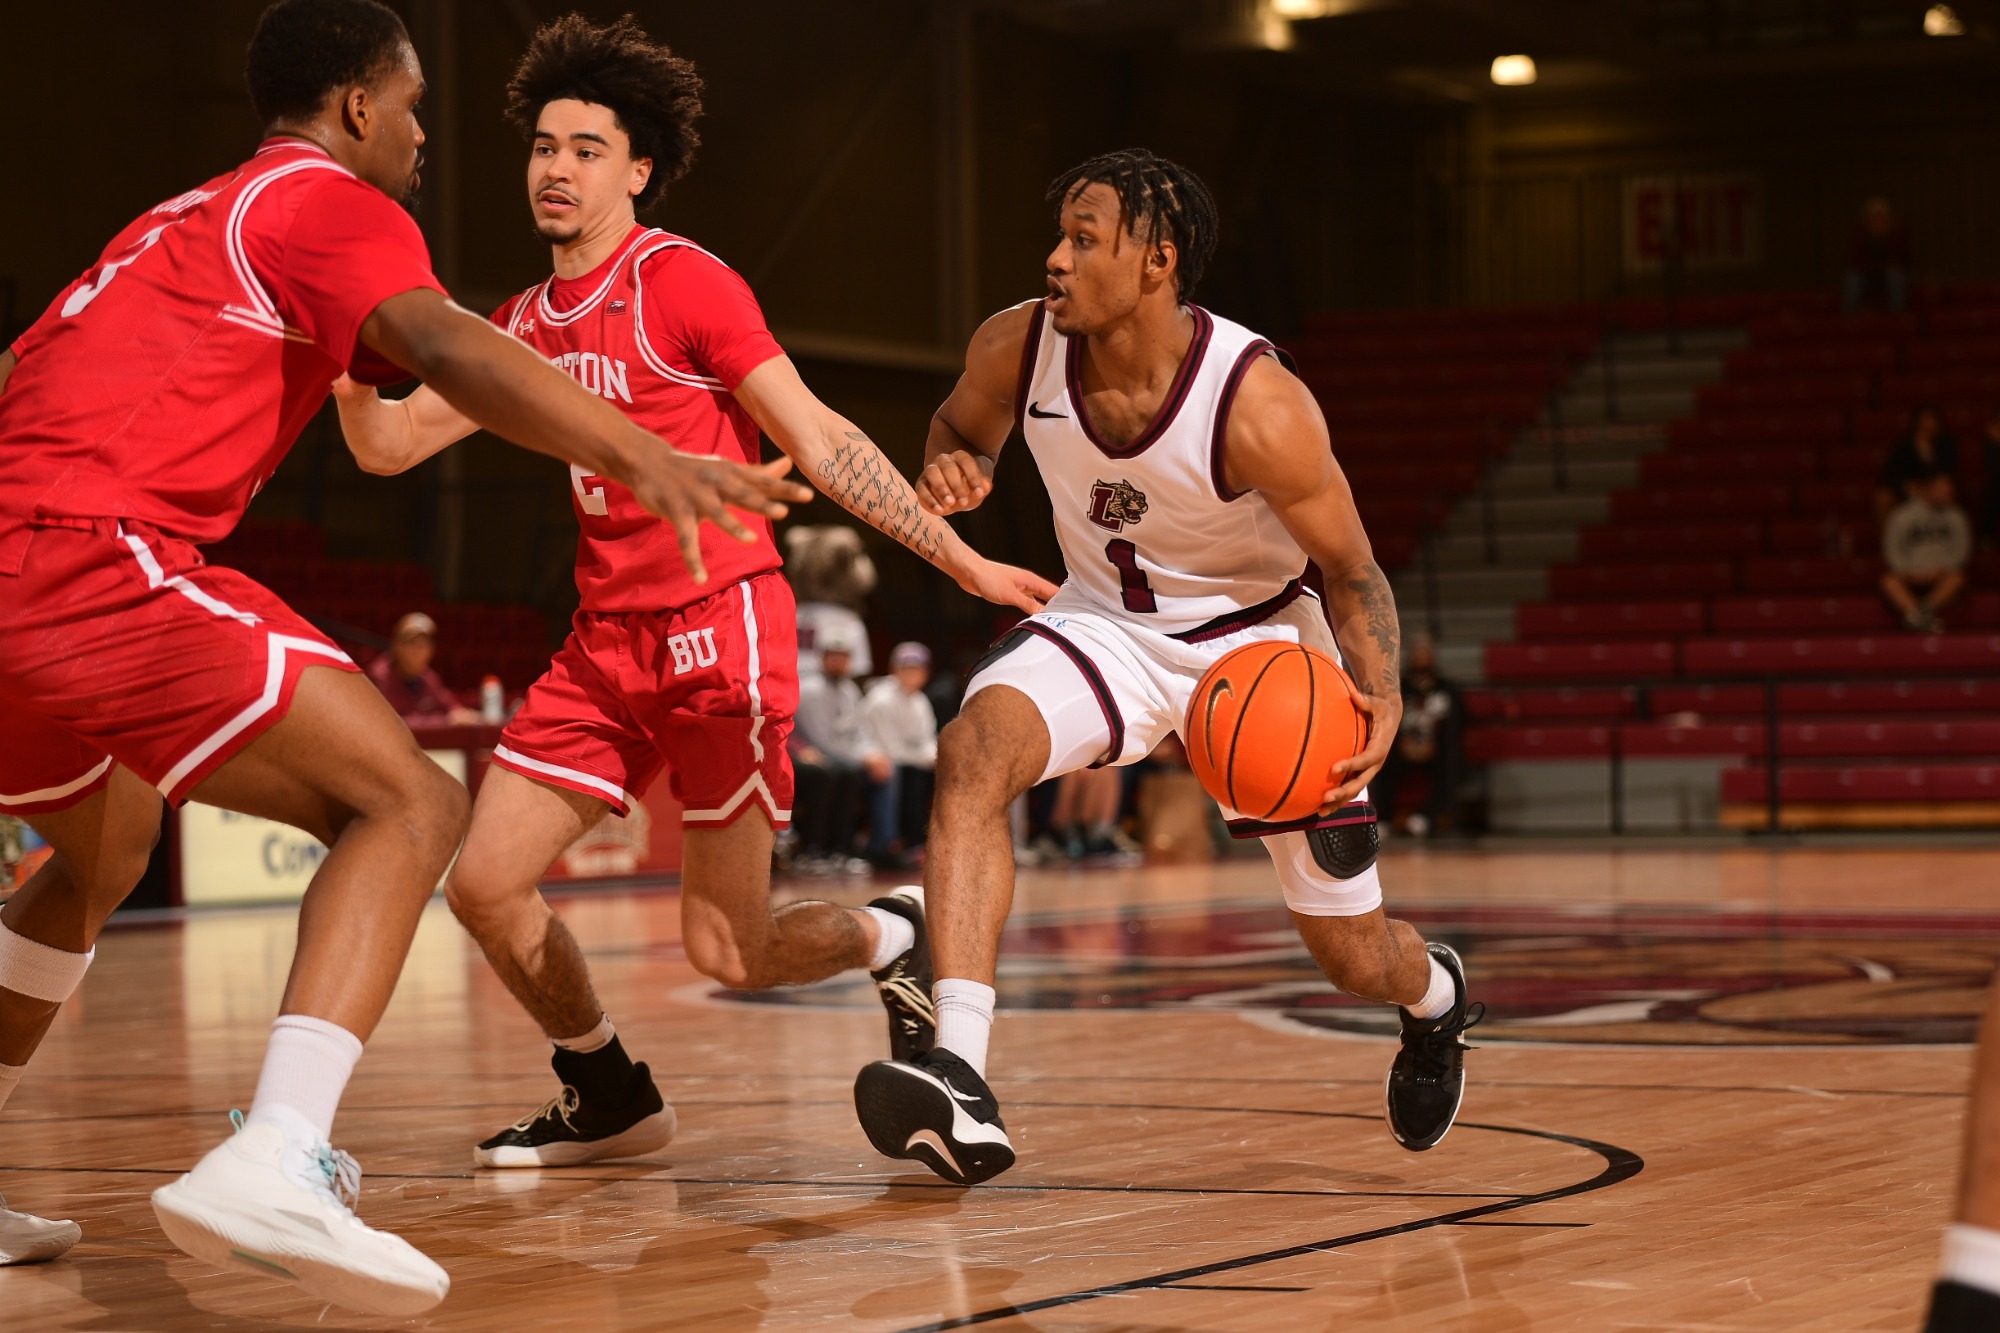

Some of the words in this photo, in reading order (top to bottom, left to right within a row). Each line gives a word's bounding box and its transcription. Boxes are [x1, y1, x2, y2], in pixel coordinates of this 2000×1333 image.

[1636, 186, 1752, 258] EXIT
[553, 352, 633, 403] TON
[884, 482, 909, 519] God
[1087, 484, 1123, 533] L
[1105, 538, 1158, 613] 1
[667, 626, 719, 676] BU
